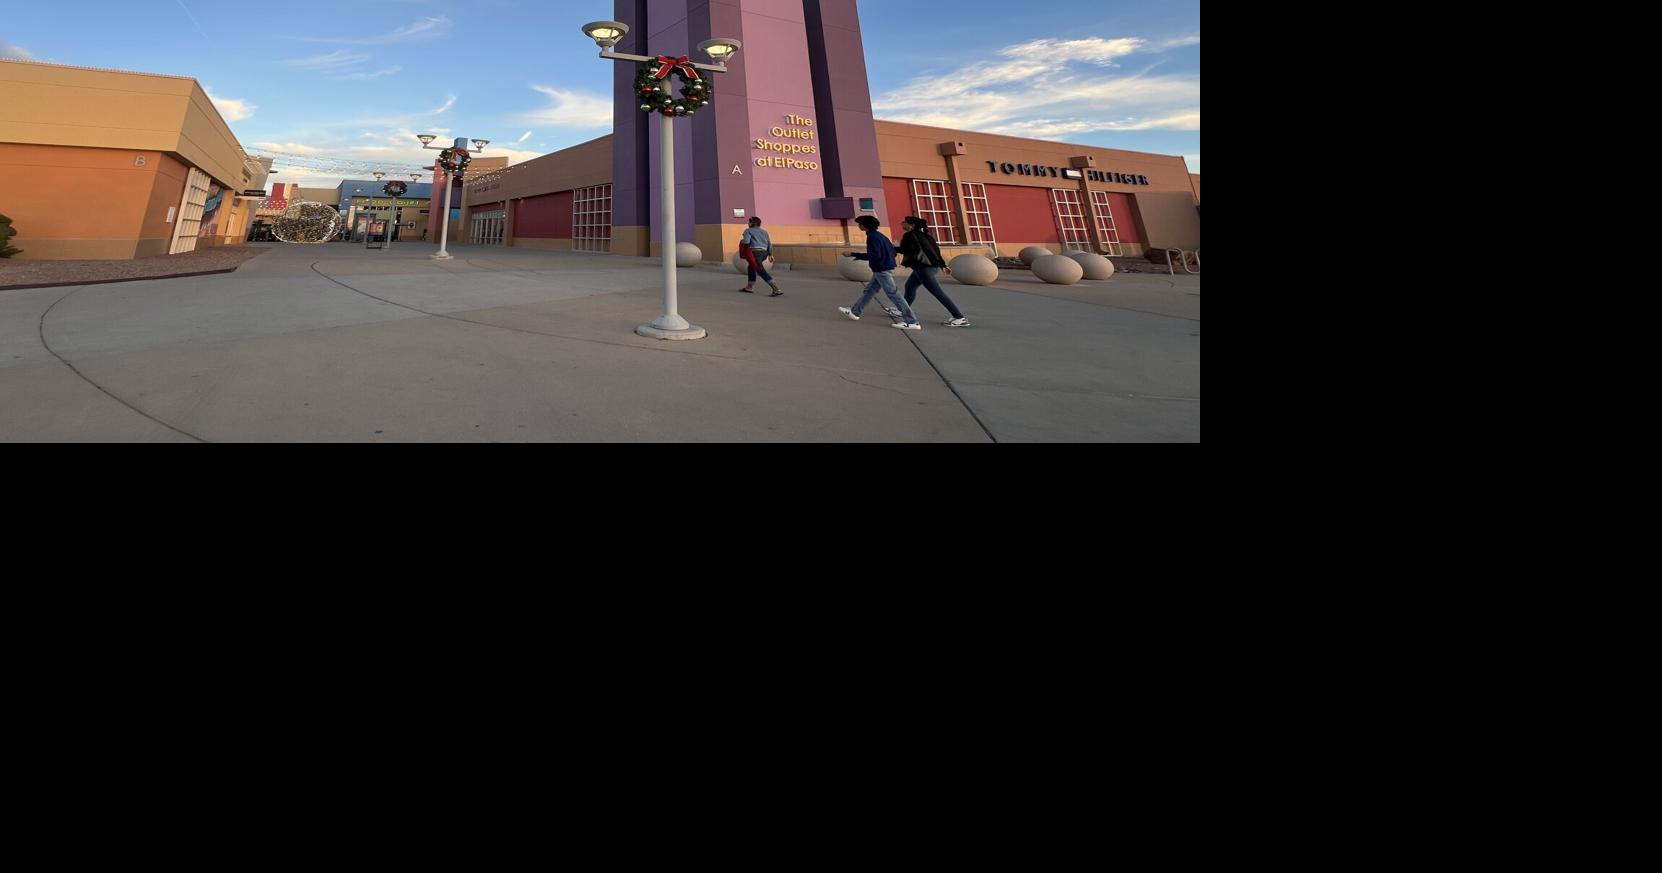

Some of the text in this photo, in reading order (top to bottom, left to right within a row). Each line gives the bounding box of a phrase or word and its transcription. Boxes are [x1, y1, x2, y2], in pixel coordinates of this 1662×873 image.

[787, 114, 813, 126] The
[771, 126, 814, 139] Outlet
[755, 138, 816, 154] Shoppes
[134, 155, 145, 166] B
[757, 156, 771, 167] at
[731, 164, 742, 175] A
[986, 160, 1059, 178] TOMMY
